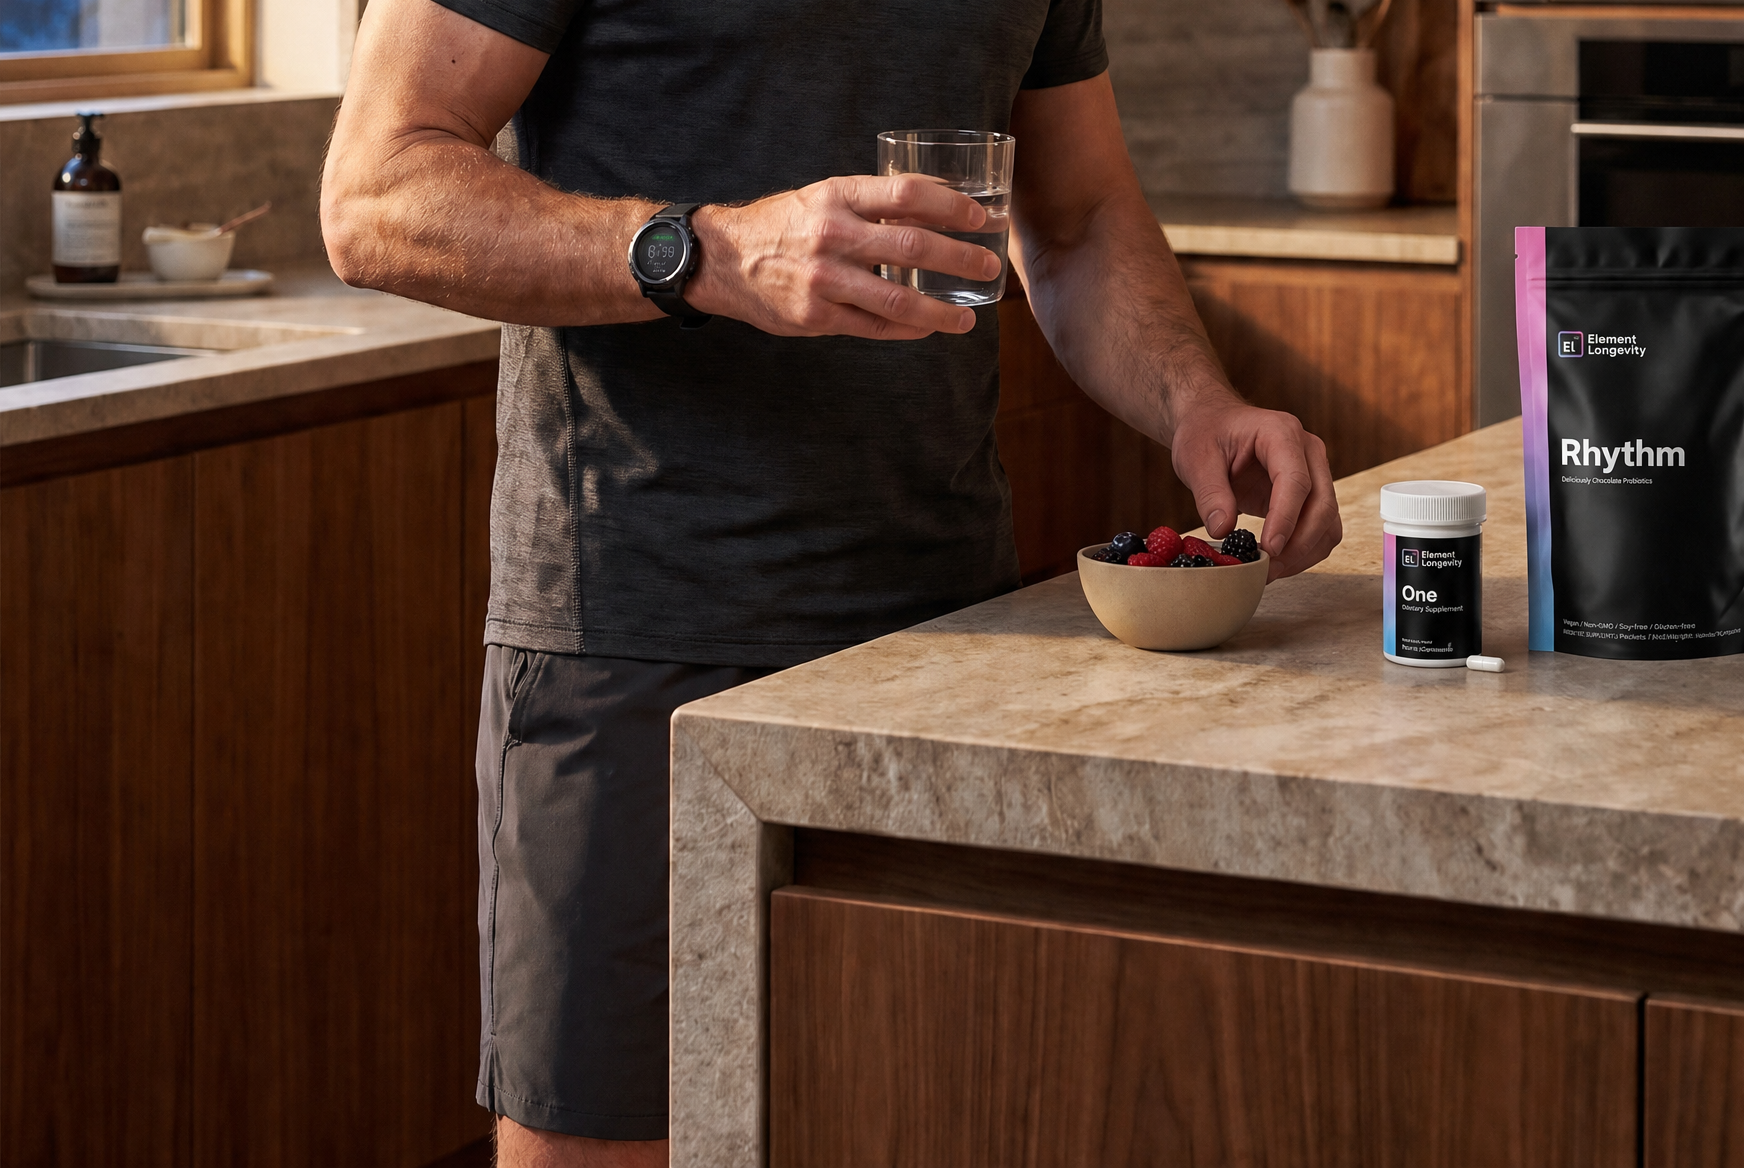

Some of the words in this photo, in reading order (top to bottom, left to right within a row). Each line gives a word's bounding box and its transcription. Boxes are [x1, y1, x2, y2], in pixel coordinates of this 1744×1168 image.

[1588, 334, 1636, 344] Element
[1588, 345, 1646, 357] Longevity
[1561, 438, 1685, 474] Rhythm
[1421, 550, 1455, 558] Element
[1421, 559, 1462, 568] Longevity
[1402, 585, 1437, 602] One
